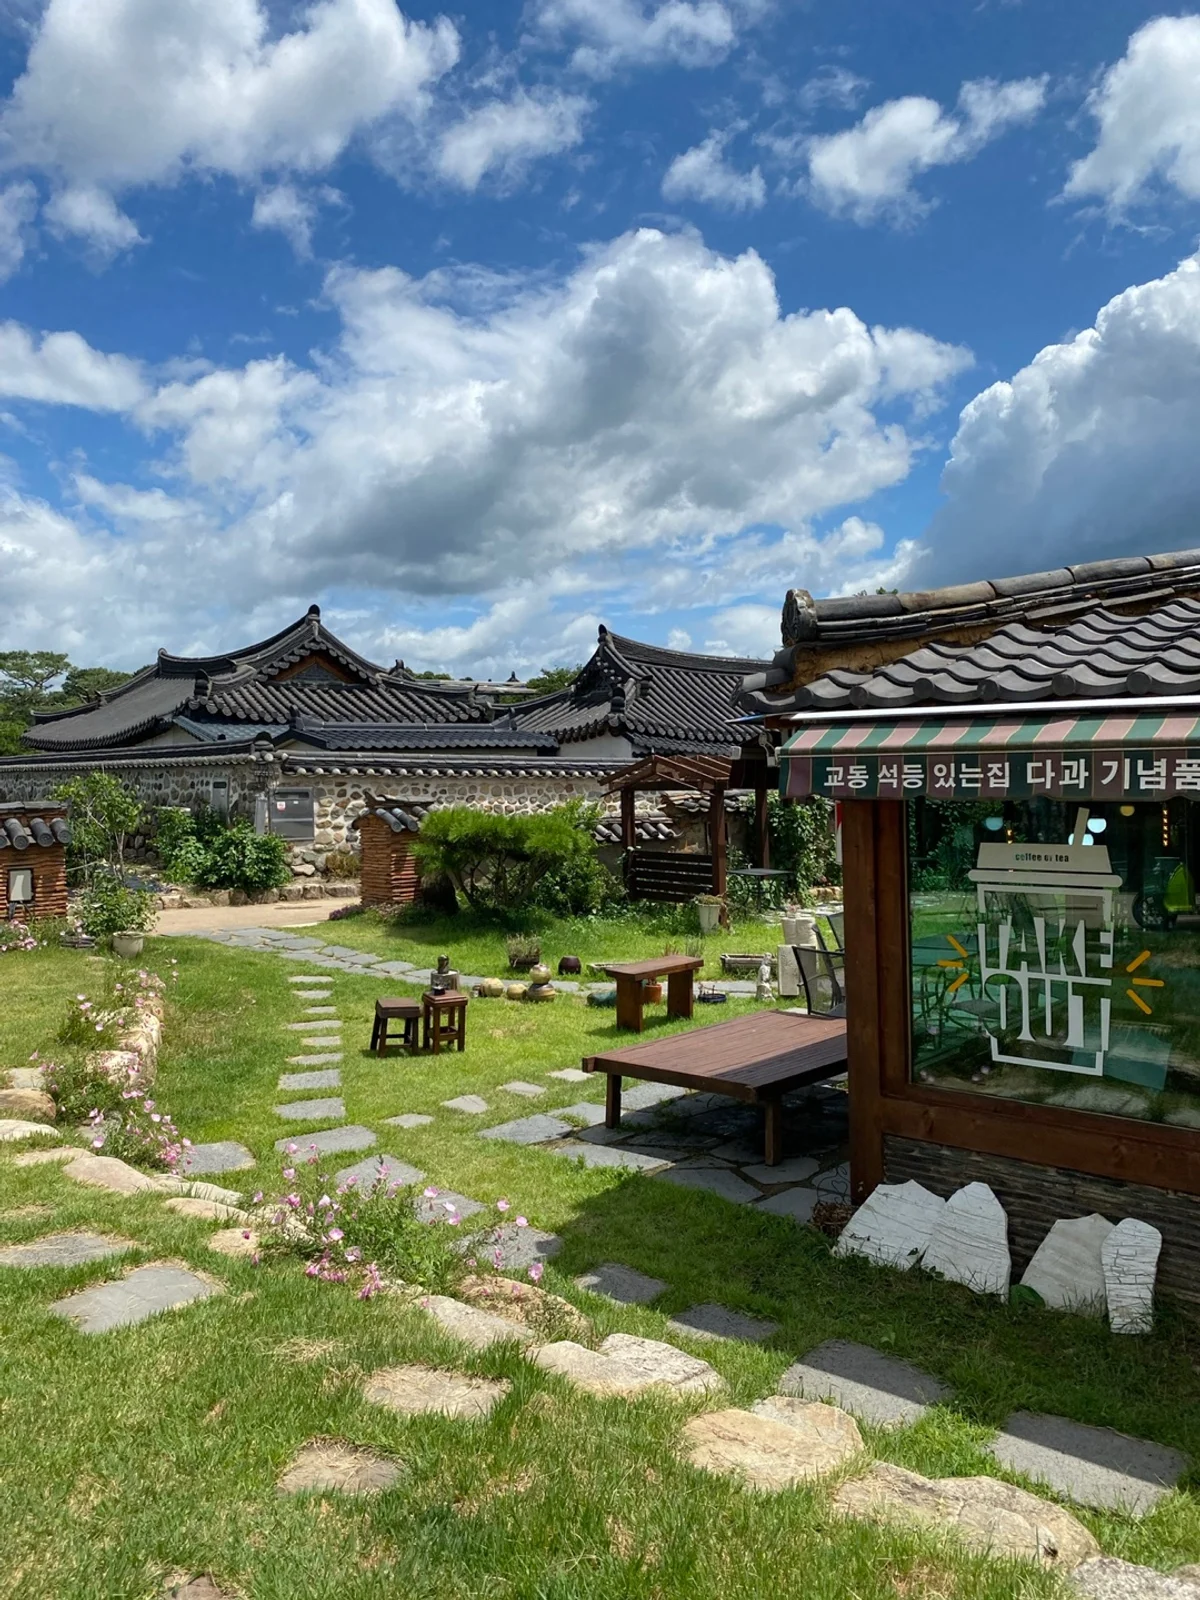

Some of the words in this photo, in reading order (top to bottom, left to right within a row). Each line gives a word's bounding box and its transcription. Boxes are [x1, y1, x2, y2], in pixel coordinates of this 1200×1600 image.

[823, 764, 869, 789] 교동
[877, 763, 925, 789] 석등
[933, 762, 1010, 789] 있는집
[1026, 758, 1089, 790] 다과
[1101, 757, 1200, 790] 기념품
[1055, 854, 1070, 863] tea
[977, 911, 1114, 979] TAKE
[983, 973, 1112, 1050] OUT
